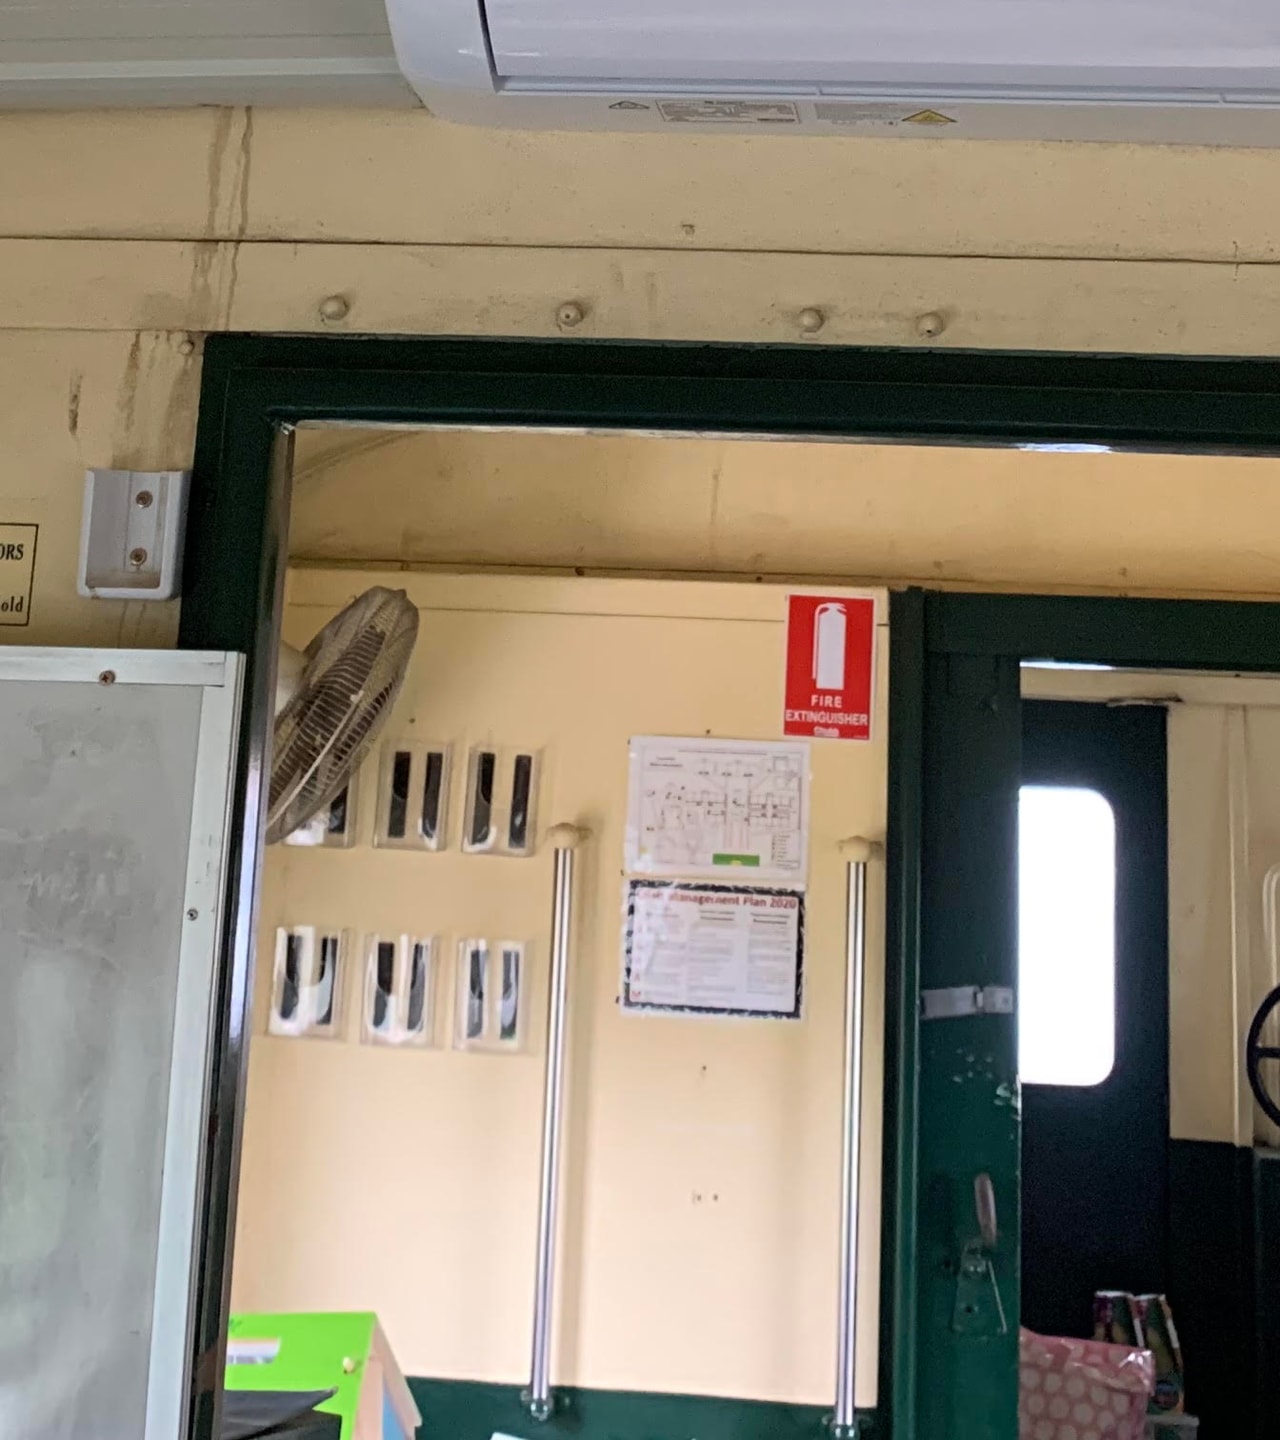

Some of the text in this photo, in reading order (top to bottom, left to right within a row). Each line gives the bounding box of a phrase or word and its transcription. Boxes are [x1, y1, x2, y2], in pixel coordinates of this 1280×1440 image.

[811, 694, 842, 708] FIRE
[785, 709, 868, 726] EXTINGUISHER
[743, 895, 767, 907] Plan
[770, 896, 797, 909] 2020
